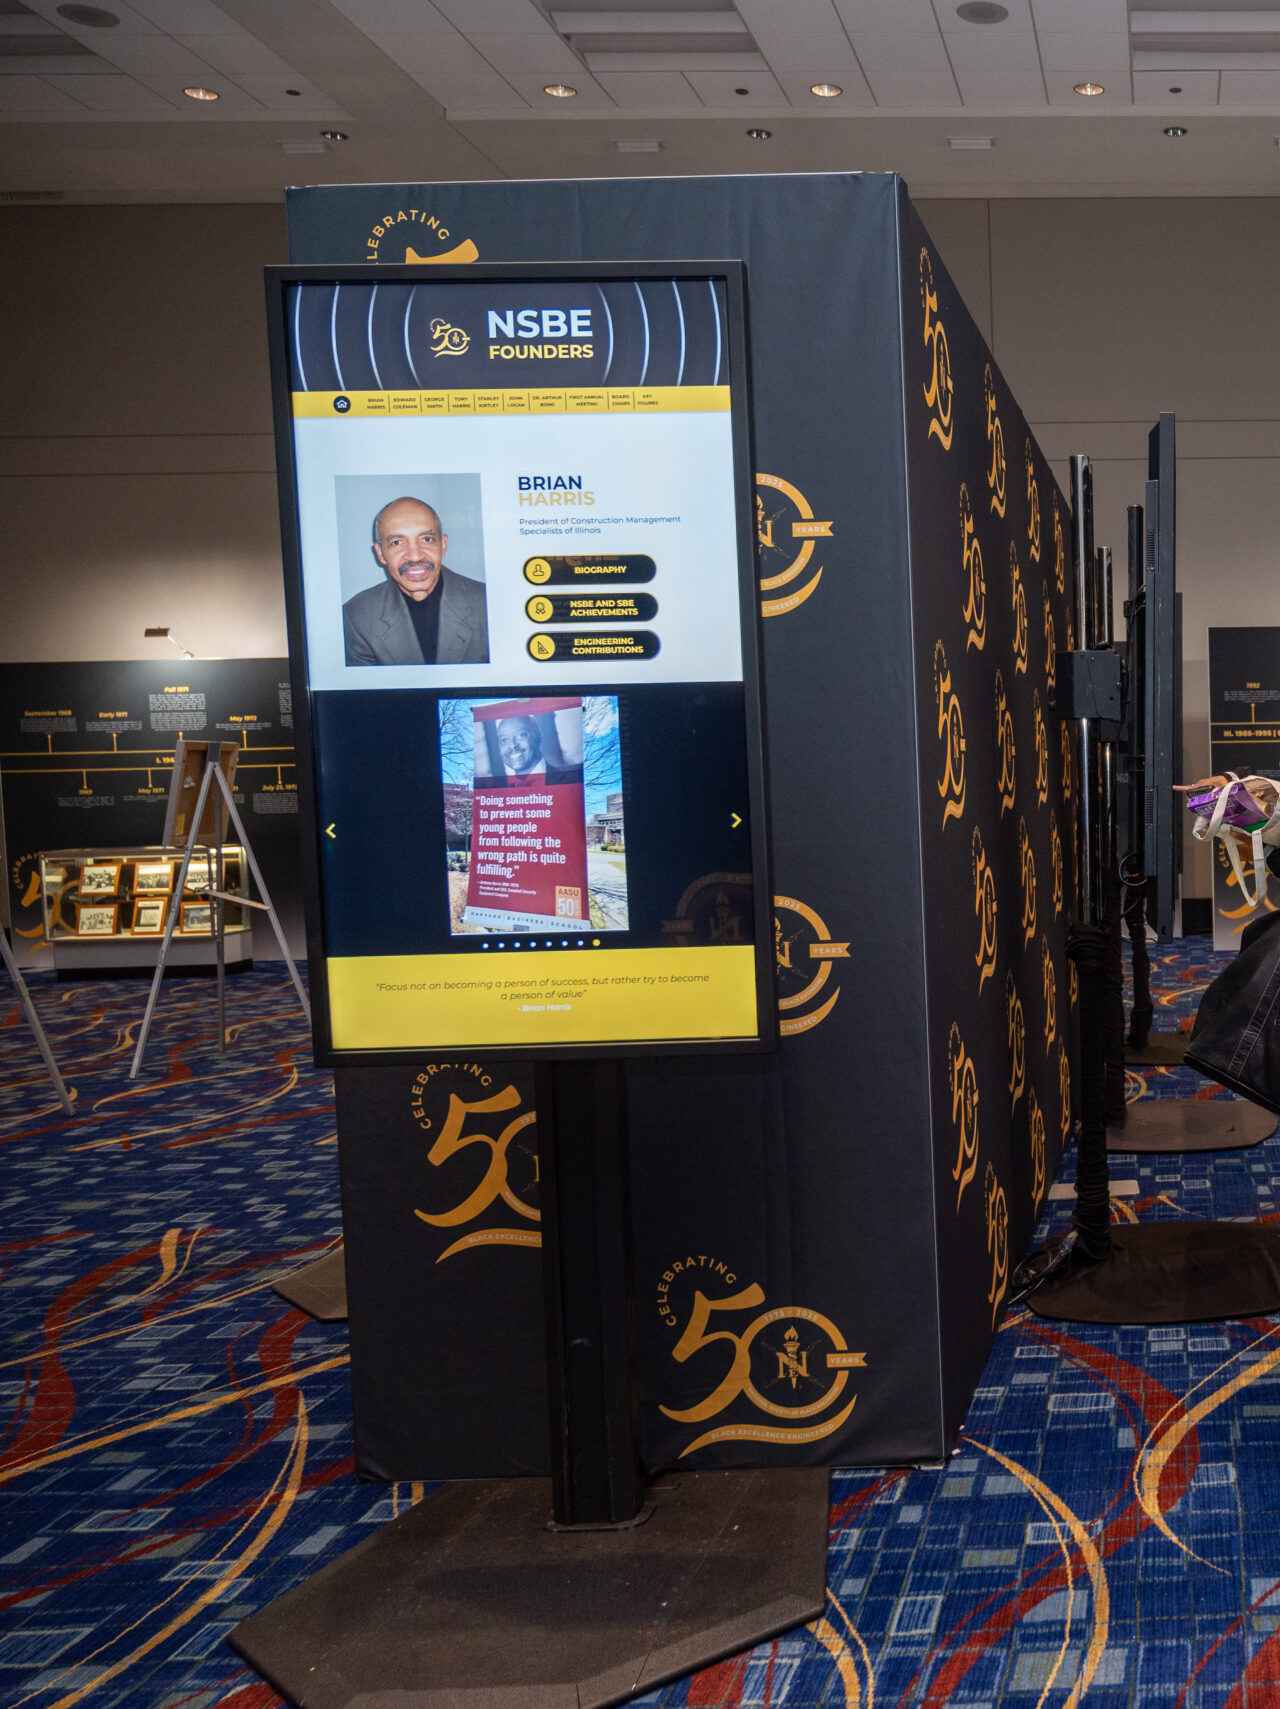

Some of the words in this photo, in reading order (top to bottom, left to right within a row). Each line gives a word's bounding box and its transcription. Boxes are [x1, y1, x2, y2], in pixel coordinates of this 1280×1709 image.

[366, 209, 450, 264] LEBRATING
[486, 307, 593, 339] NSBE
[489, 343, 594, 360] FOUNDERS
[518, 475, 582, 491] BRIAN
[518, 491, 596, 507] HARRIS
[519, 517, 558, 526] President
[560, 517, 569, 525] of
[570, 516, 624, 525] Construction
[625, 516, 682, 526] Management
[519, 527, 563, 536] Specialists
[564, 527, 573, 535] of
[574, 526, 602, 535] Illinois
[795, 525, 826, 535] YEARS
[573, 565, 628, 575] BIOGRAPHY
[569, 600, 595, 608] NSBE
[595, 599, 616, 608] AND
[617, 599, 635, 607] SBE
[569, 607, 640, 617] ACHIEVEMENTS
[573, 637, 635, 646] ENGINEERING
[571, 645, 645, 655] CONTRIBUTIONS
[505, 793, 554, 806] something
[480, 808, 489, 819] to
[490, 808, 524, 820] prevent
[525, 809, 551, 818] some
[479, 823, 505, 834] young
[506, 821, 538, 834] people
[478, 835, 500, 847] from
[501, 835, 543, 849] following
[544, 836, 561, 848] the
[477, 850, 505, 863] wrong
[506, 850, 528, 863] path
[529, 850, 538, 862] is
[540, 852, 567, 865] quite
[558, 888, 579, 897] AASU
[557, 898, 575, 916] 50
[813, 946, 844, 955] YEARS
[443, 981, 493, 991] becoming
[504, 979, 537, 988] person
[539, 978, 551, 987] of
[551, 978, 590, 987] success,
[592, 976, 609, 985] but
[611, 976, 641, 985] rather
[643, 976, 657, 985] try
[658, 975, 669, 983] to
[670, 974, 711, 983] become
[509, 991, 543, 1001] person
[545, 990, 555, 999] of
[522, 1004, 545, 1012] Brian
[547, 1002, 572, 1012] Harris
[656, 1255, 737, 1327] CELEBRATING
[829, 1356, 860, 1365] YEARS
[710, 1428, 737, 1440] BLACK
